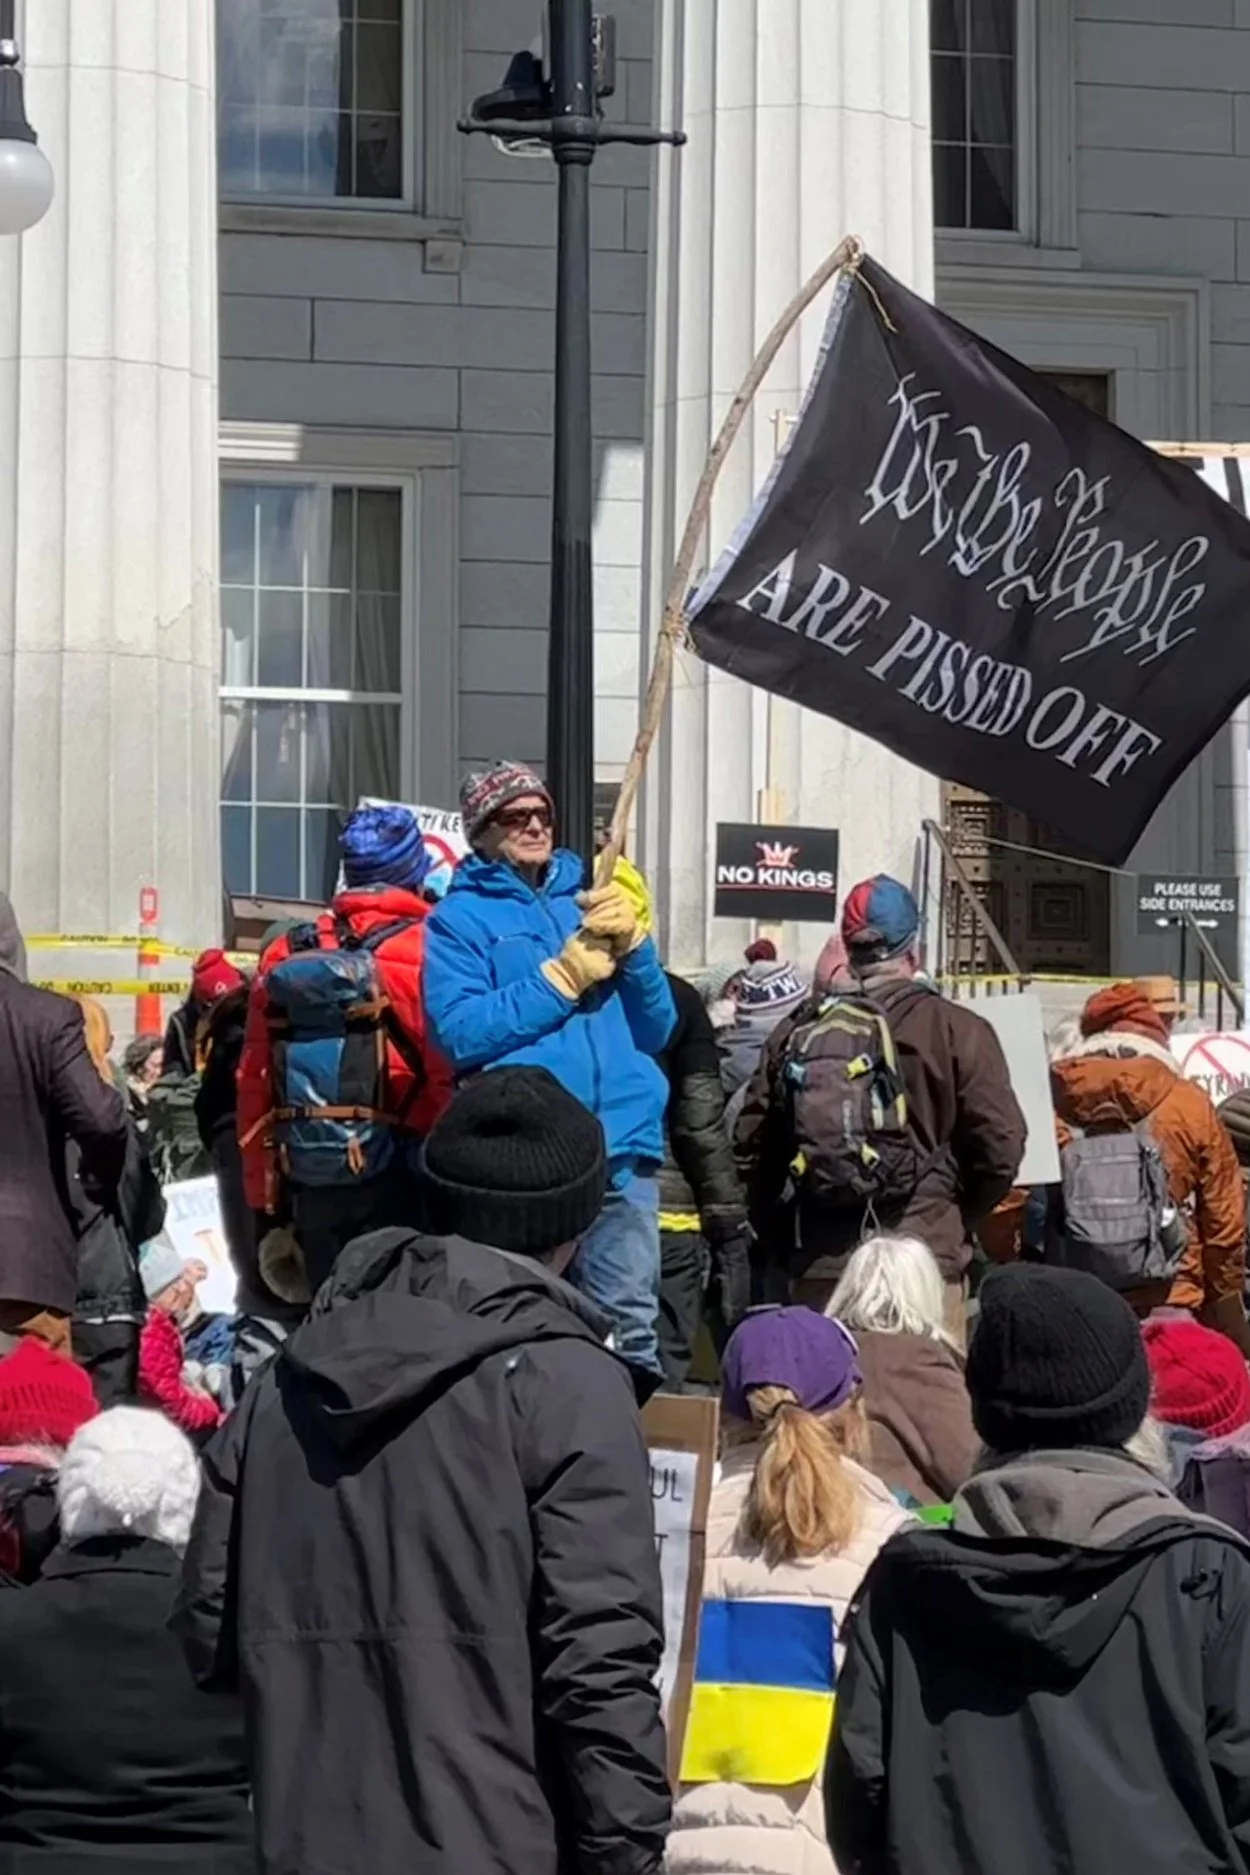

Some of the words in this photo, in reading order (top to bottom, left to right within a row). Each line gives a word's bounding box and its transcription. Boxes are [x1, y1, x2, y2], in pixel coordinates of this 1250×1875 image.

[736, 548, 891, 658] ARE
[865, 615, 1033, 737] PISSED
[1025, 686, 1162, 788] OFF
[717, 865, 754, 883] NO
[758, 867, 834, 888] KINGS
[1154, 882, 1197, 897] PLEASE
[1198, 882, 1222, 897] USE
[1140, 896, 1166, 911] SIDE
[1168, 897, 1235, 912] ENTRANCES
